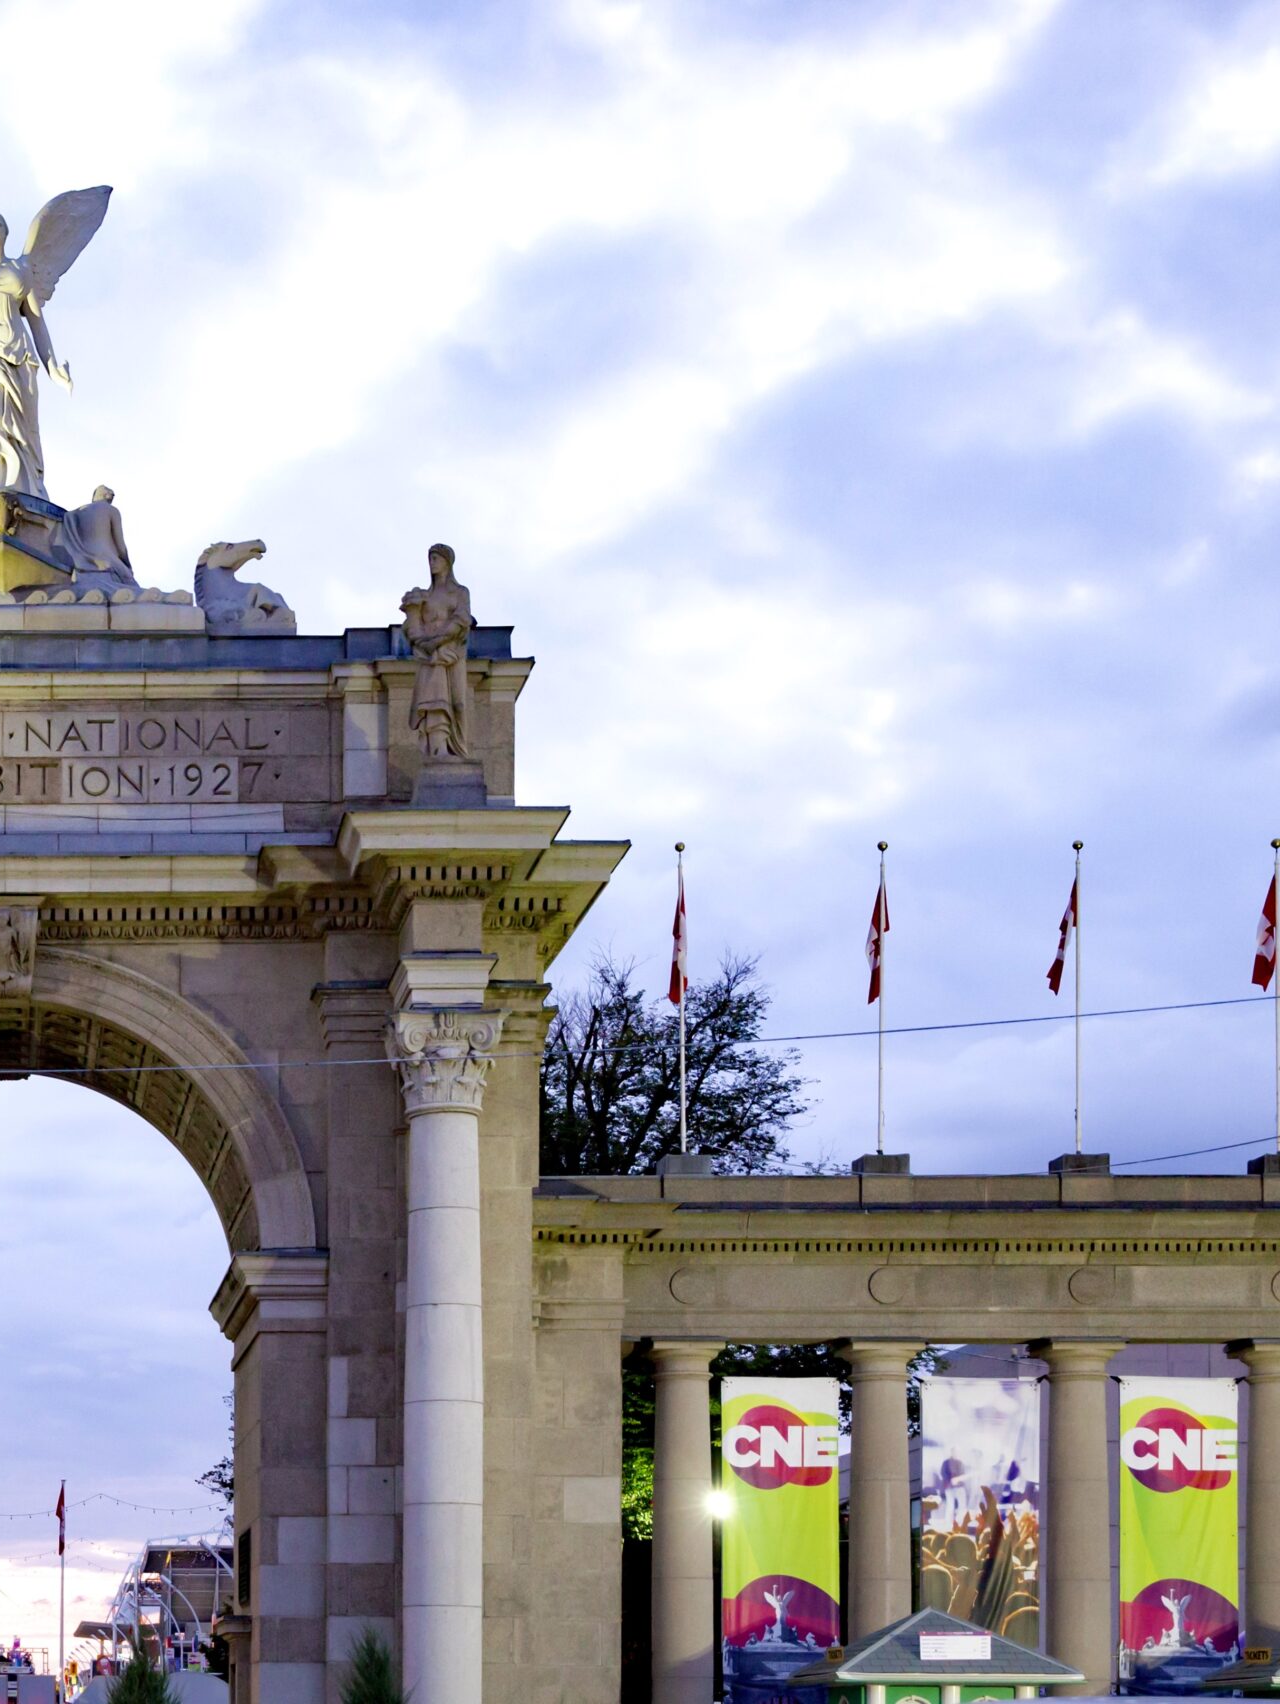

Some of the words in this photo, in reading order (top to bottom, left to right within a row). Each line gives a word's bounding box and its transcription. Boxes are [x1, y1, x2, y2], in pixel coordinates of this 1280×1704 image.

[25, 718, 269, 751] NATIONAL
[169, 763, 264, 796] 1927
[722, 1424, 838, 1468] CNE
[1121, 1427, 1238, 1471] CNE
